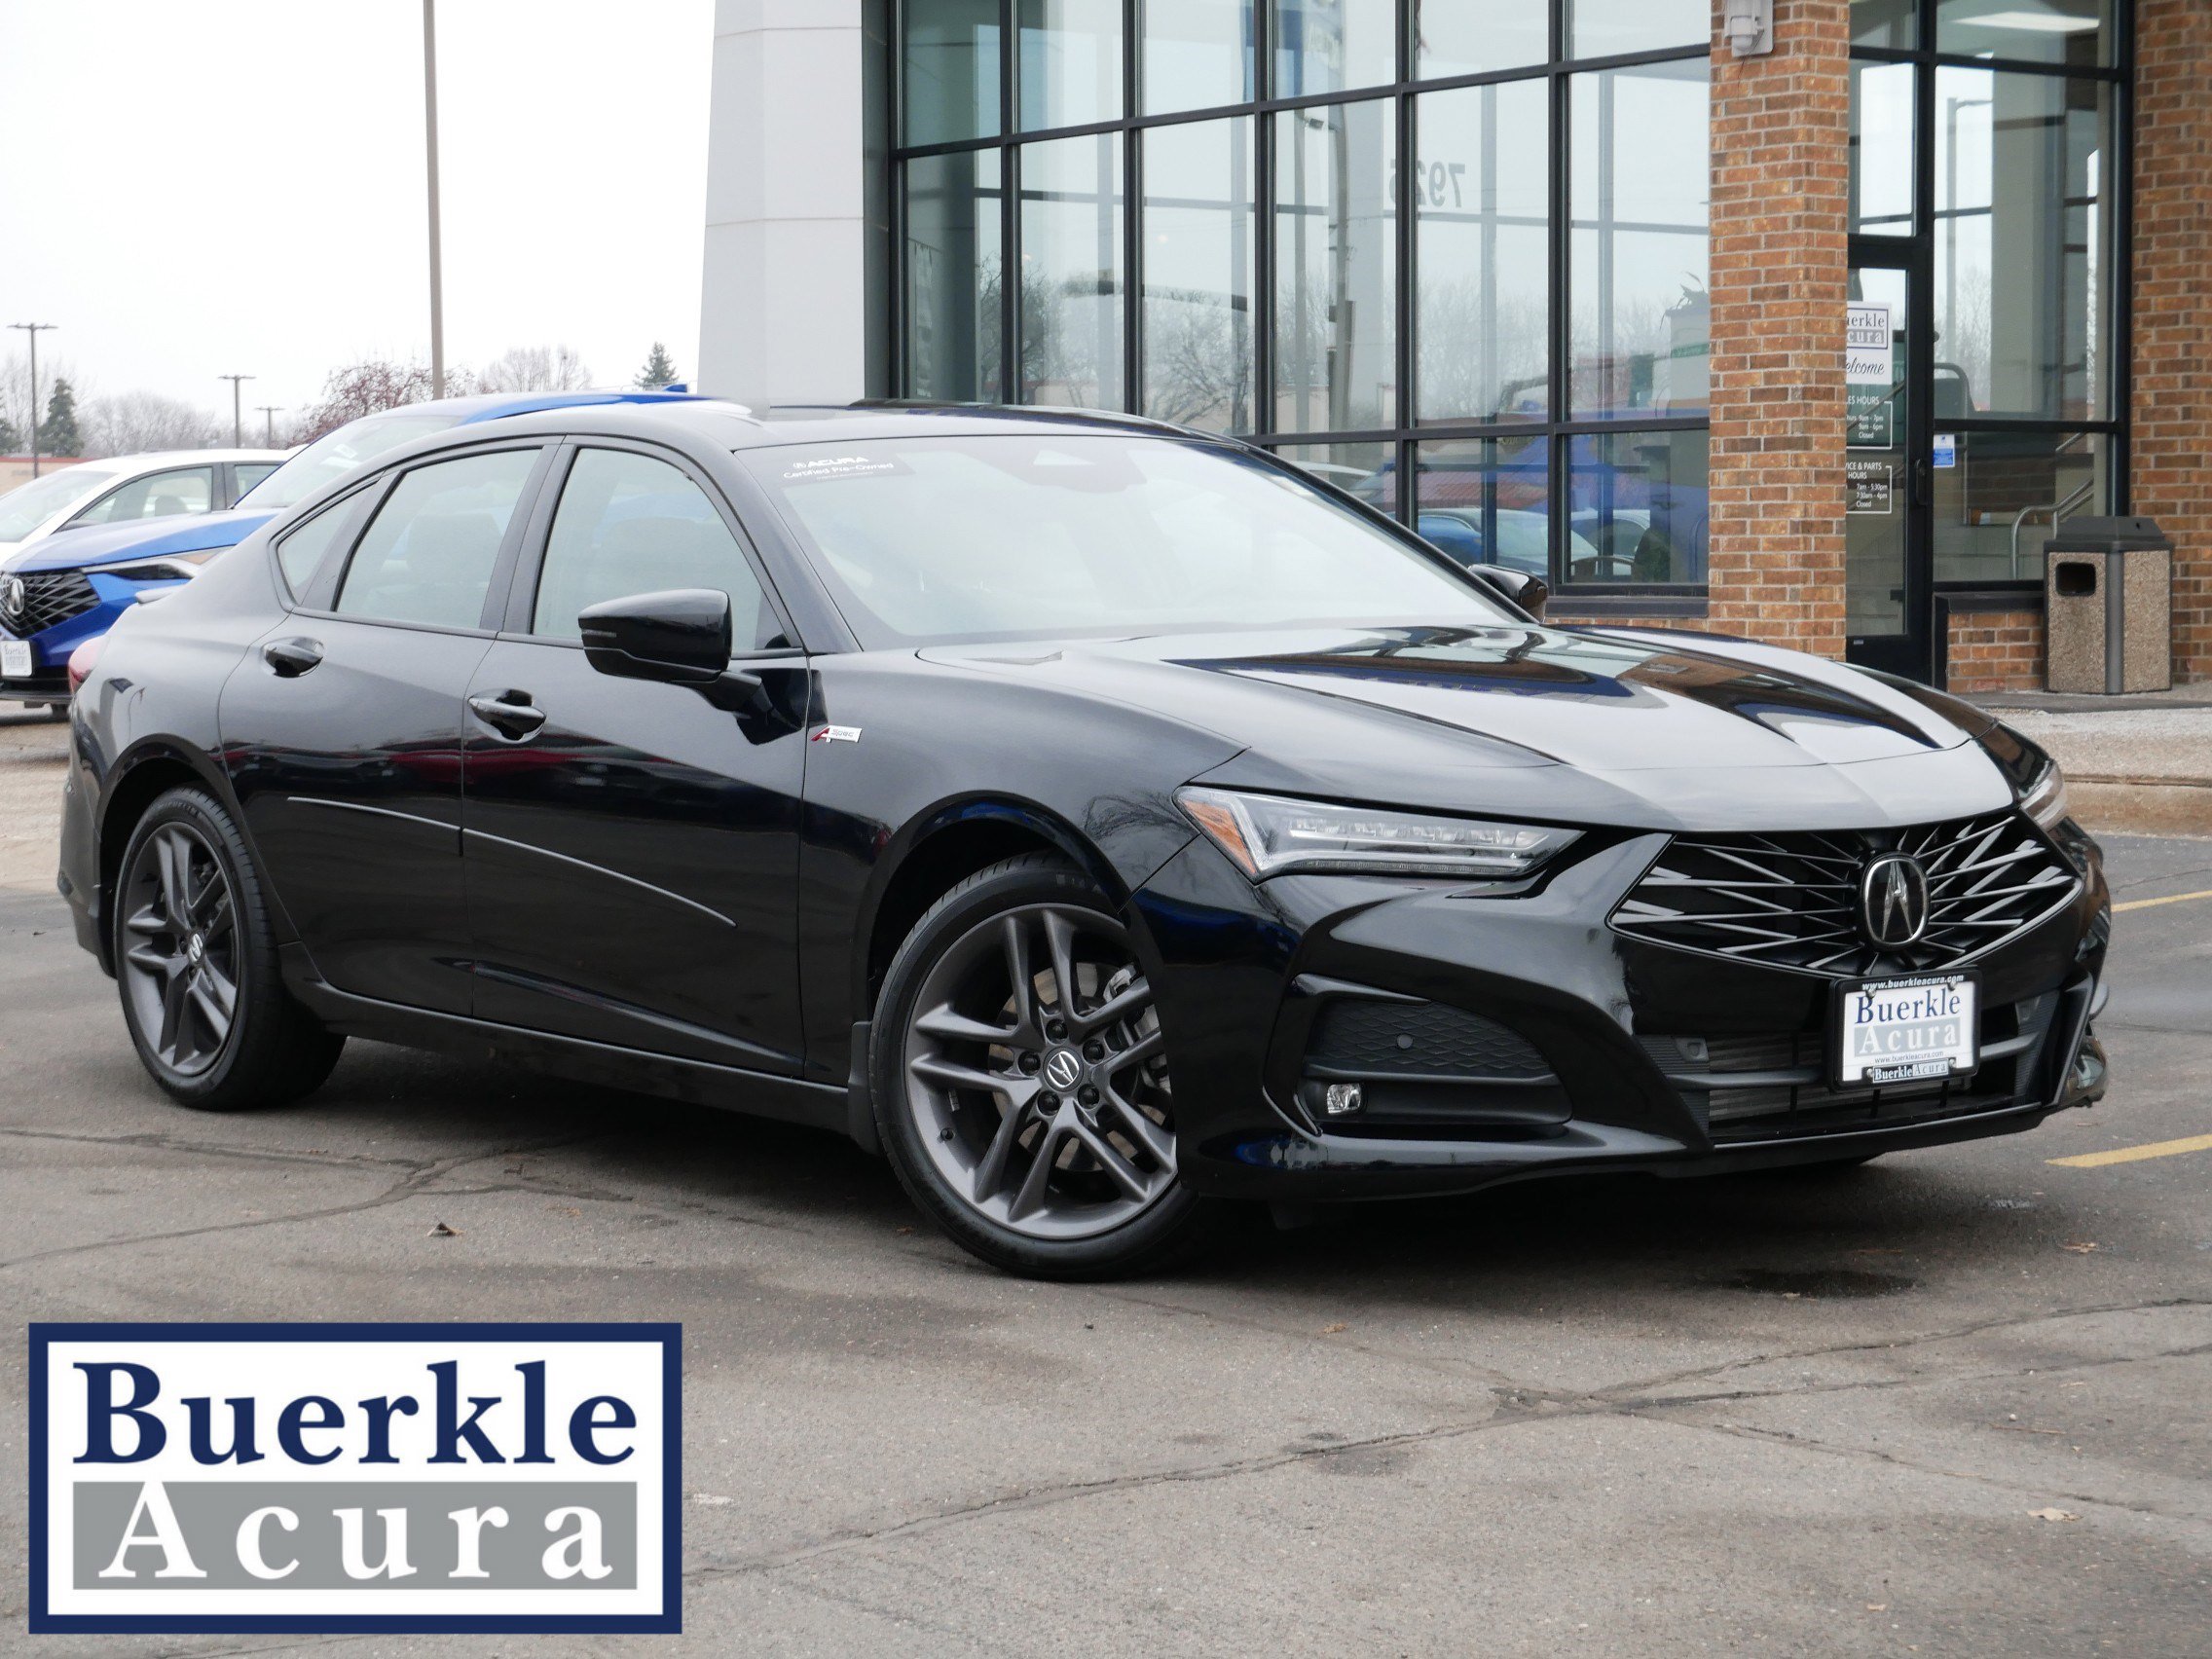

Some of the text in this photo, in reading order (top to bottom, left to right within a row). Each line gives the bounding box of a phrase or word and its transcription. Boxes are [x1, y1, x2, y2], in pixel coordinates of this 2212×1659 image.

[1847, 331, 1882, 344] cura
[1846, 356, 1885, 375] elcome
[1857, 395, 1879, 405] HOURS
[808, 457, 868, 468] ACURA
[1863, 461, 1882, 471] PARTS
[1862, 975, 1964, 991] www.buerkleacura.com
[1855, 987, 1960, 1024] Buerkle
[1859, 1023, 1957, 1054] Acura
[1874, 1051, 1943, 1064] www.buerkleacura.com
